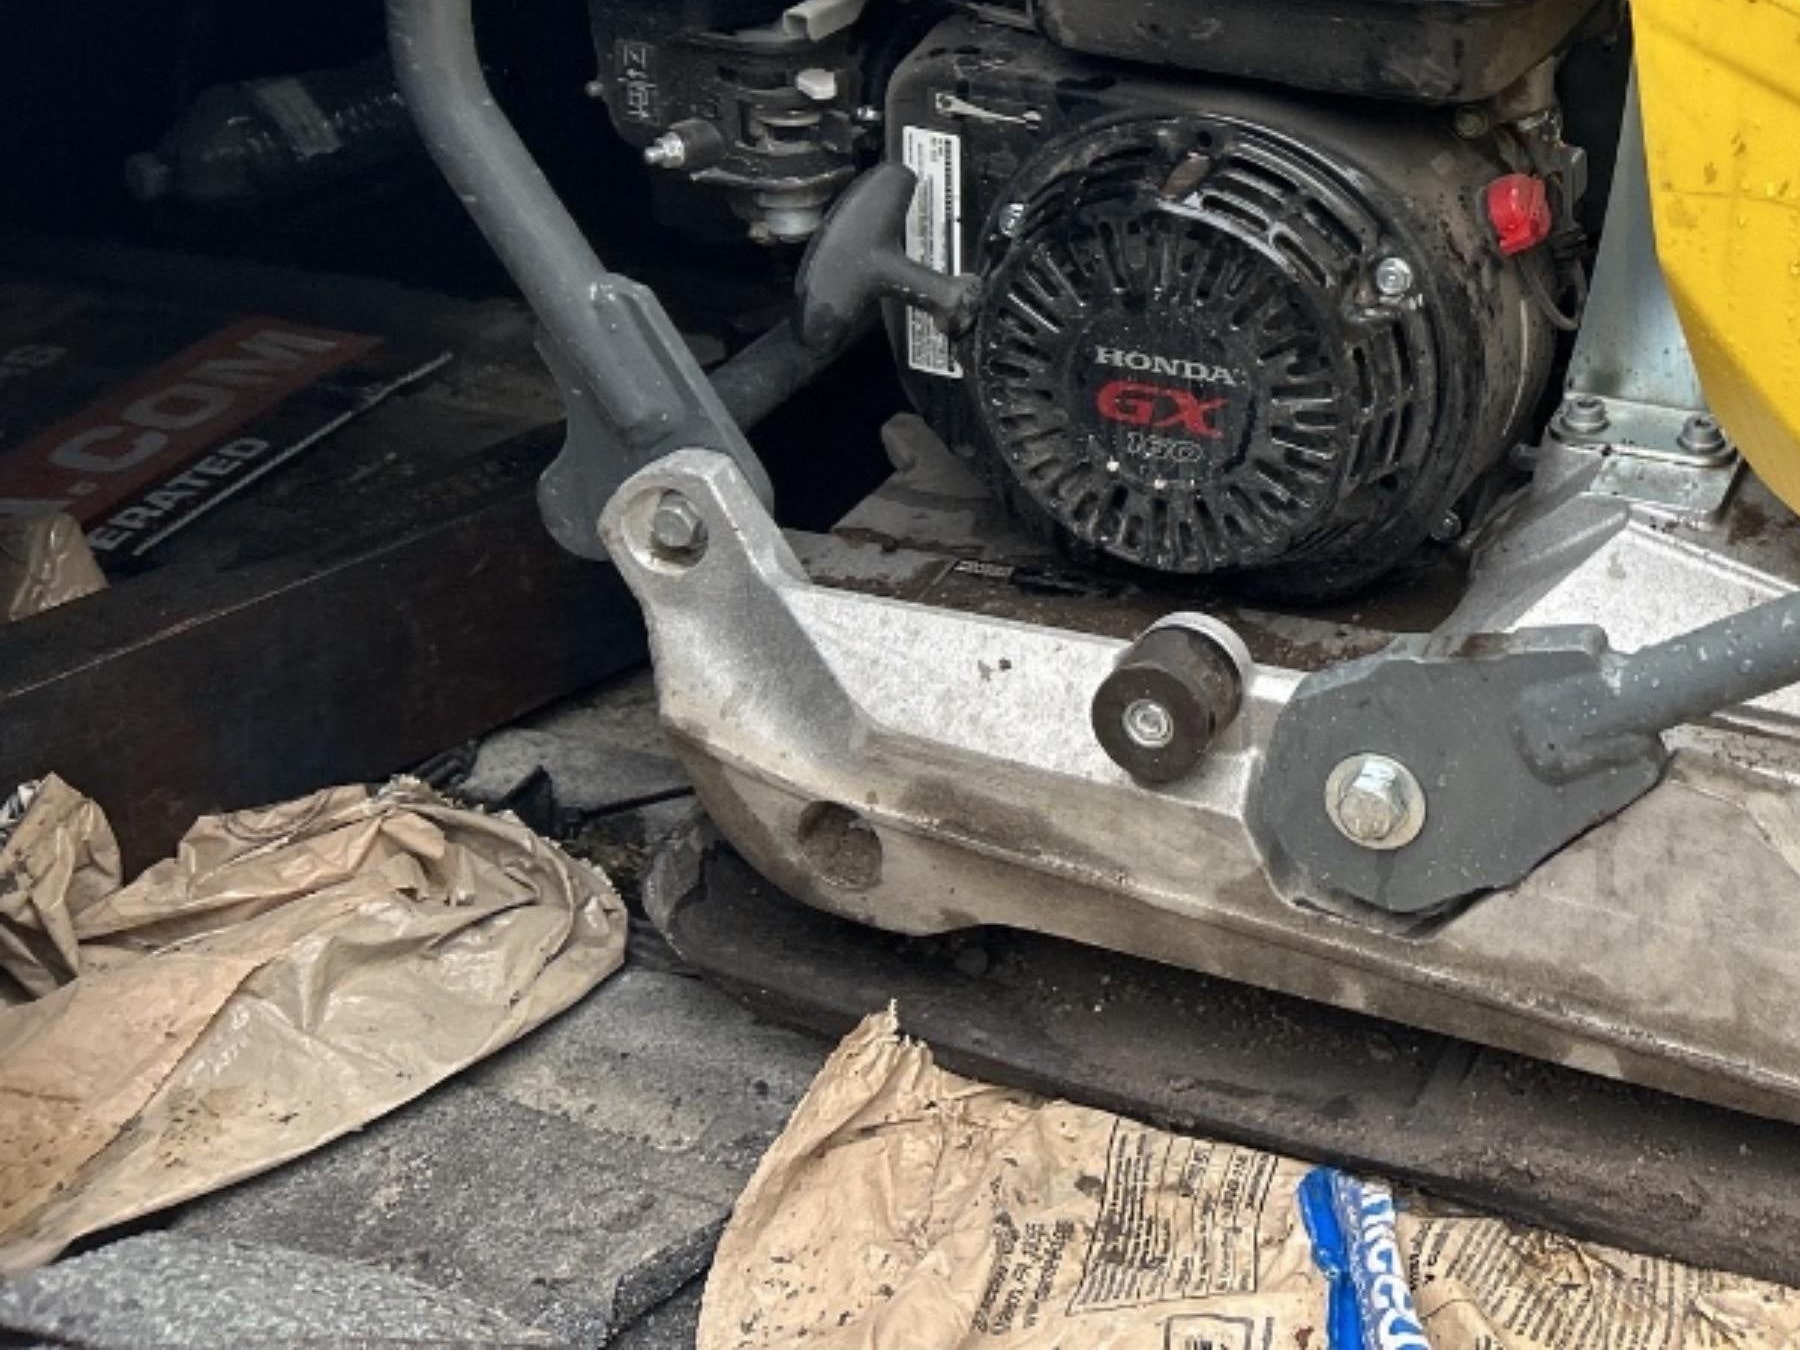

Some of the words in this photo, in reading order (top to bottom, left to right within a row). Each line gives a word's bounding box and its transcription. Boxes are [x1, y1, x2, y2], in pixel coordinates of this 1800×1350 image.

[1095, 345, 1238, 388] HONDA
[1097, 380, 1228, 439] GX
[0, 329, 338, 518] .COM
[86, 436, 271, 552] ERATED
